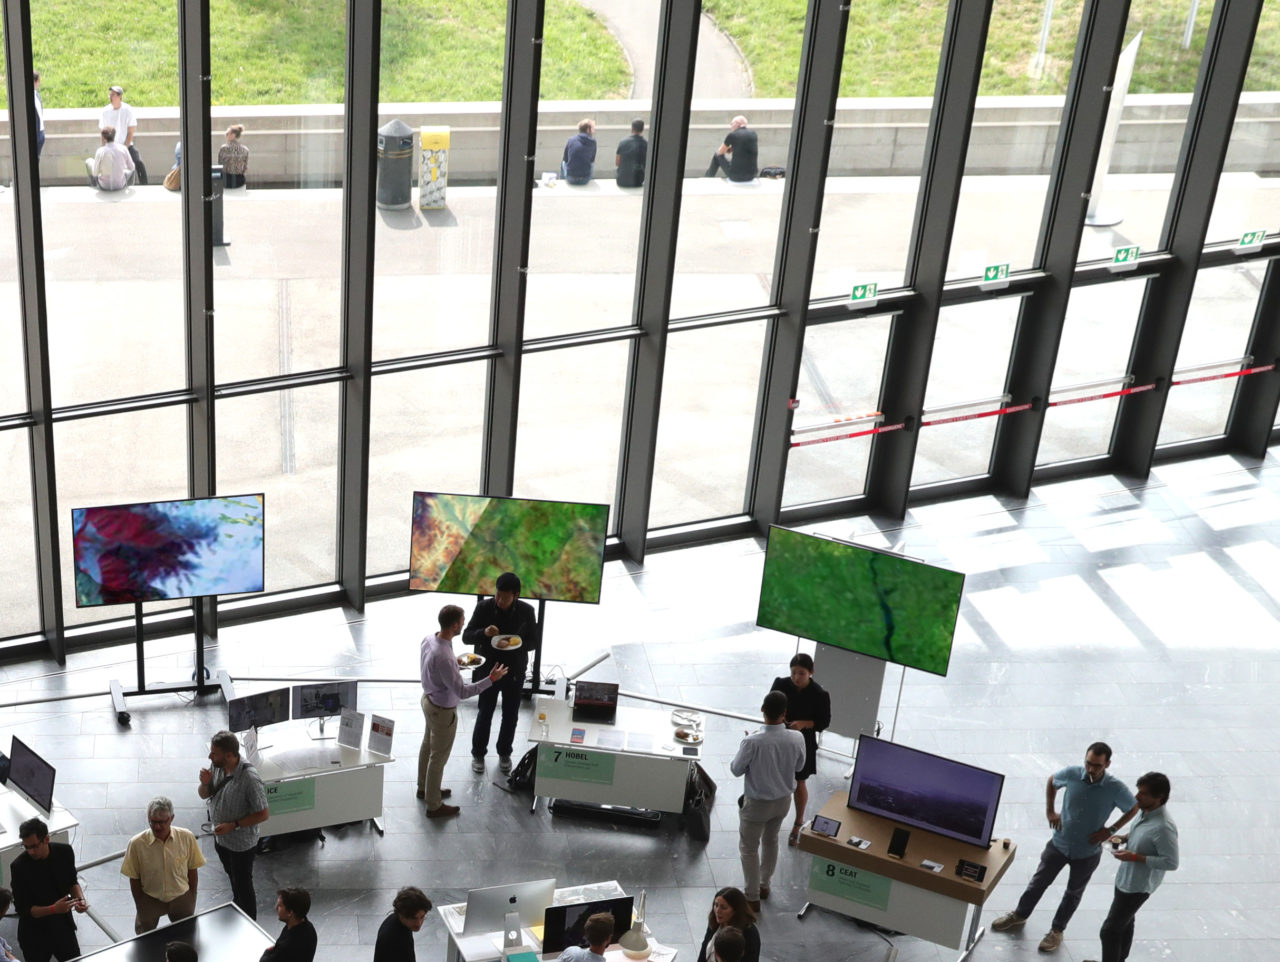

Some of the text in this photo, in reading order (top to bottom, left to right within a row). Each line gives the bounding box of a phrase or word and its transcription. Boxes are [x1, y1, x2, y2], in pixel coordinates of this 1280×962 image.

[553, 751, 588, 763] 7 HOBEL
[826, 864, 858, 878] 8 CEAT
